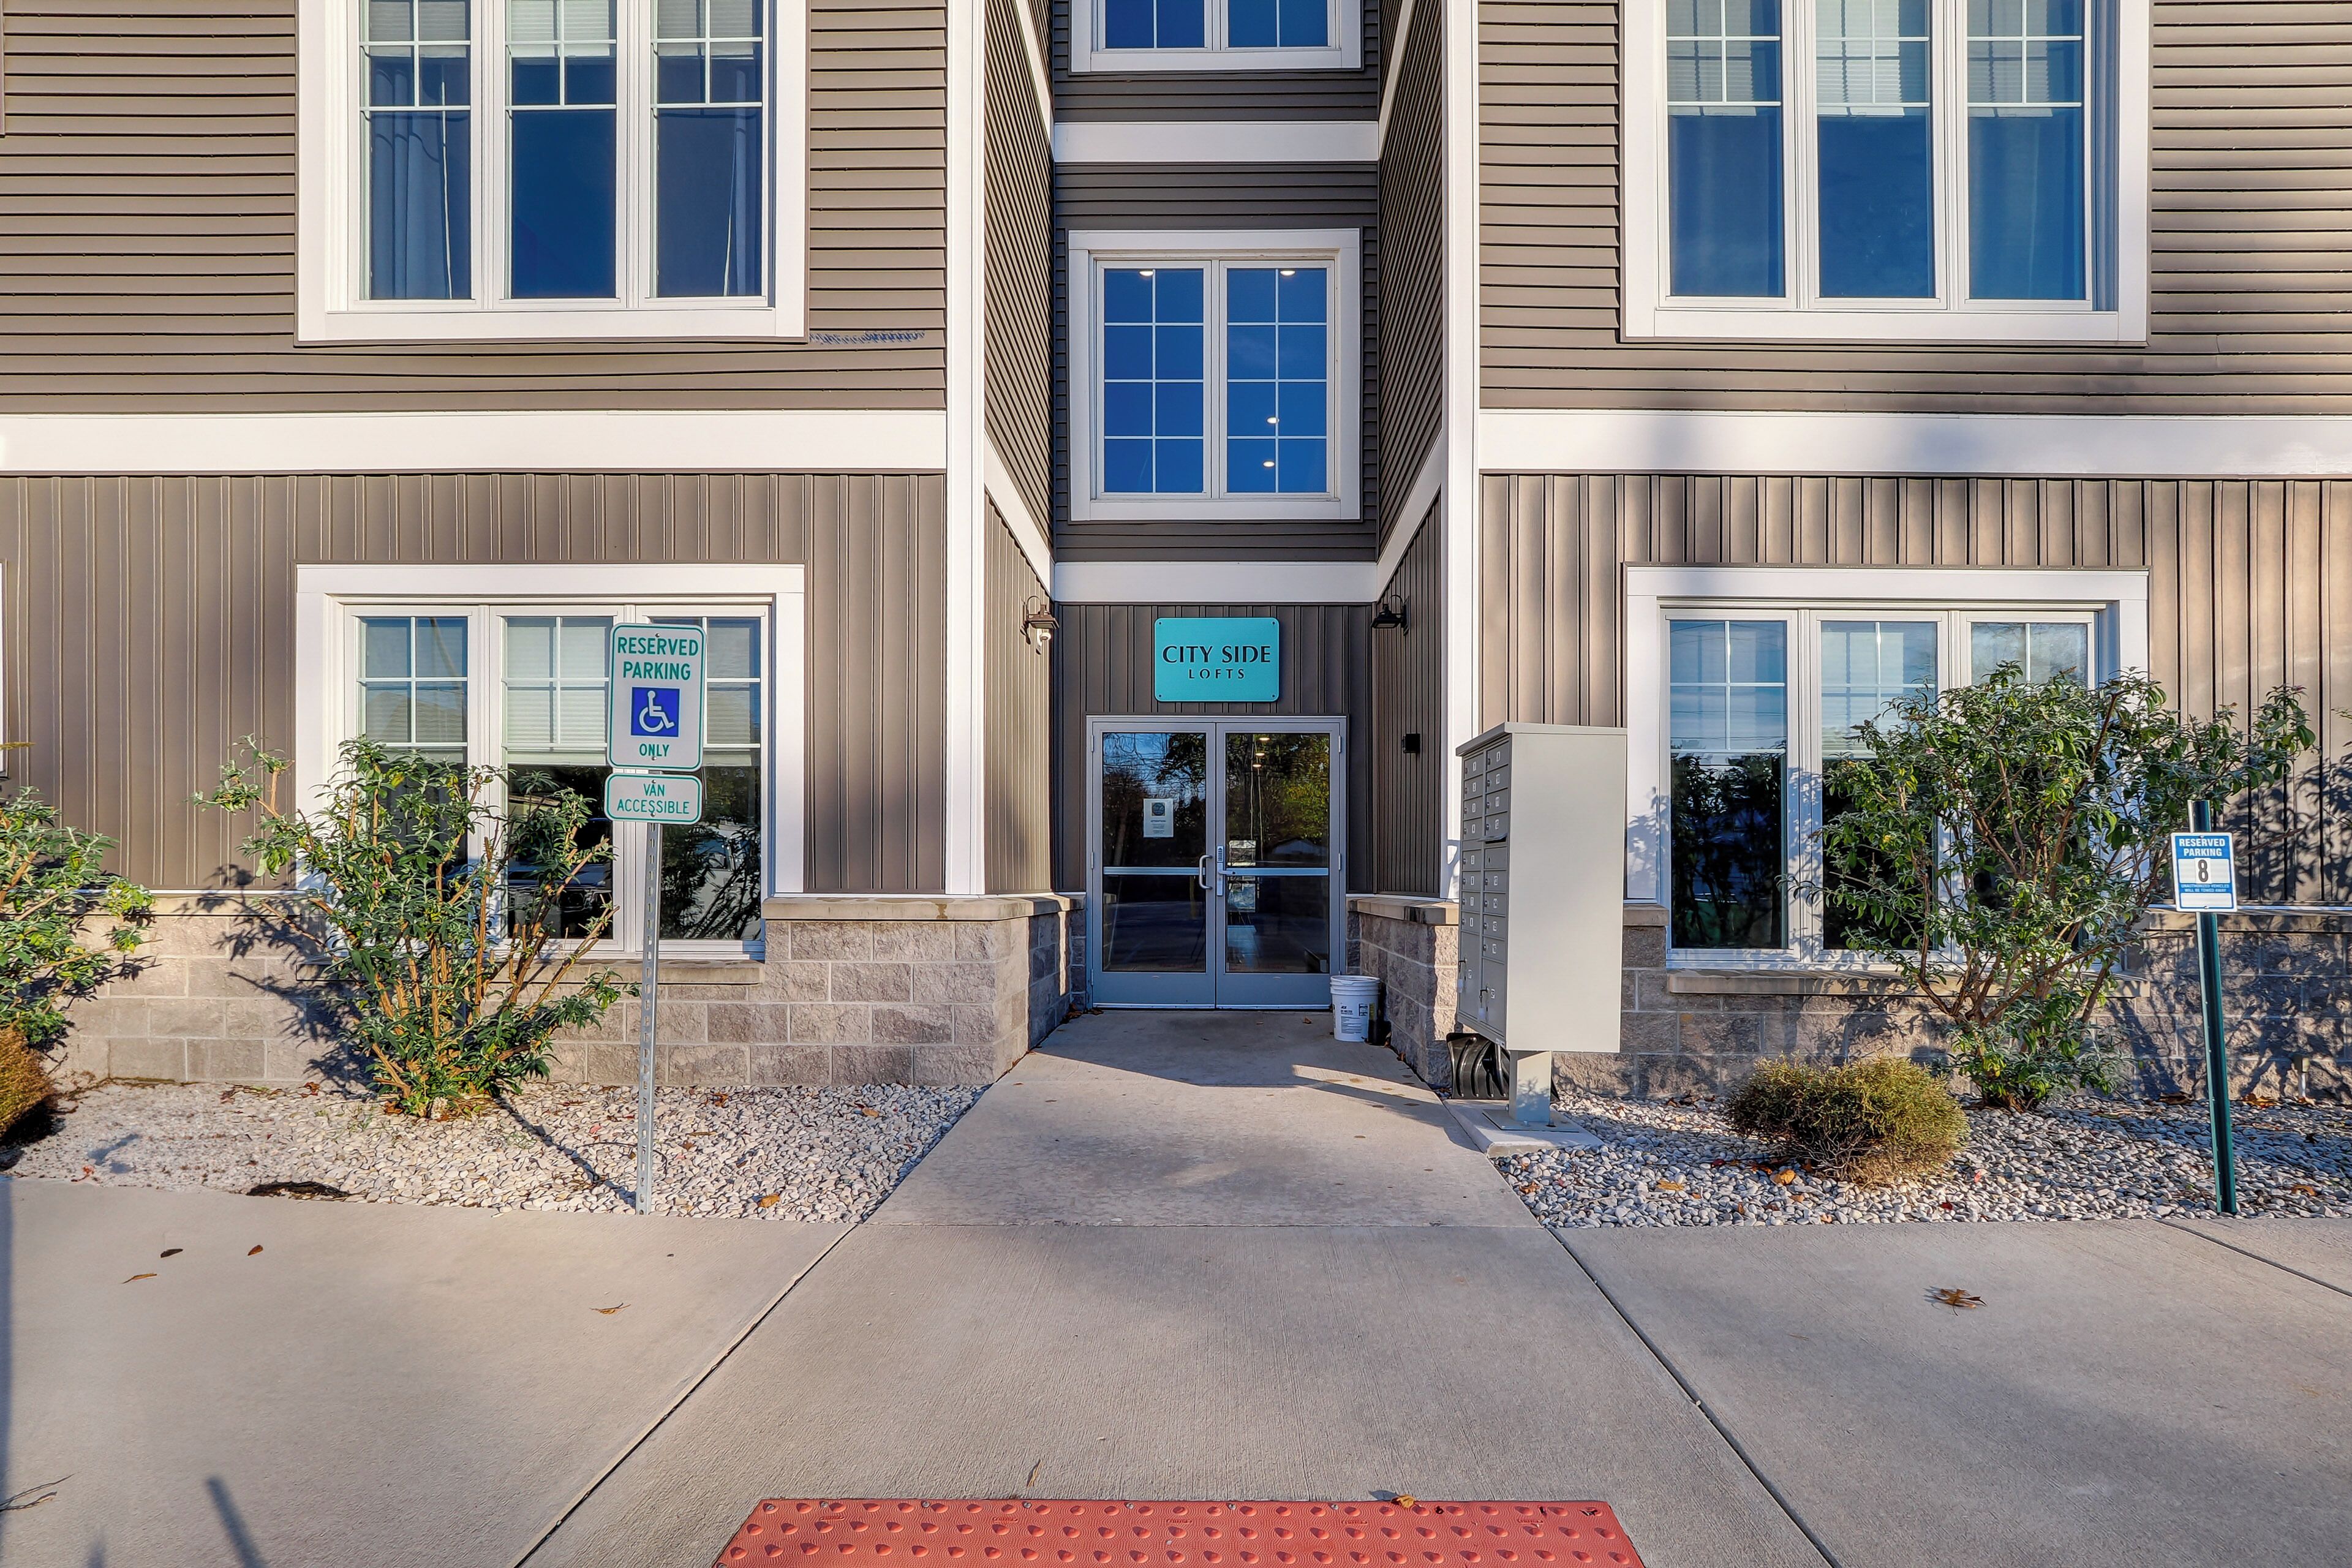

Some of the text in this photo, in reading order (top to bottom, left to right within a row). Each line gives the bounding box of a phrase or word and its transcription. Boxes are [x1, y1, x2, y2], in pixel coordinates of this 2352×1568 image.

[617, 636, 699, 657] RESERVED
[1162, 645, 1271, 663] CITY SIDE
[622, 661, 691, 681] PARKING
[1188, 668, 1245, 679] LOFTS
[639, 742, 670, 757] ONLY
[643, 783, 665, 797] VAN
[616, 798, 690, 814] ACCESSIBLE
[2179, 838, 2226, 847] RESERVED
[2183, 848, 2222, 856] PARKING
[2198, 859, 2209, 883] 8
